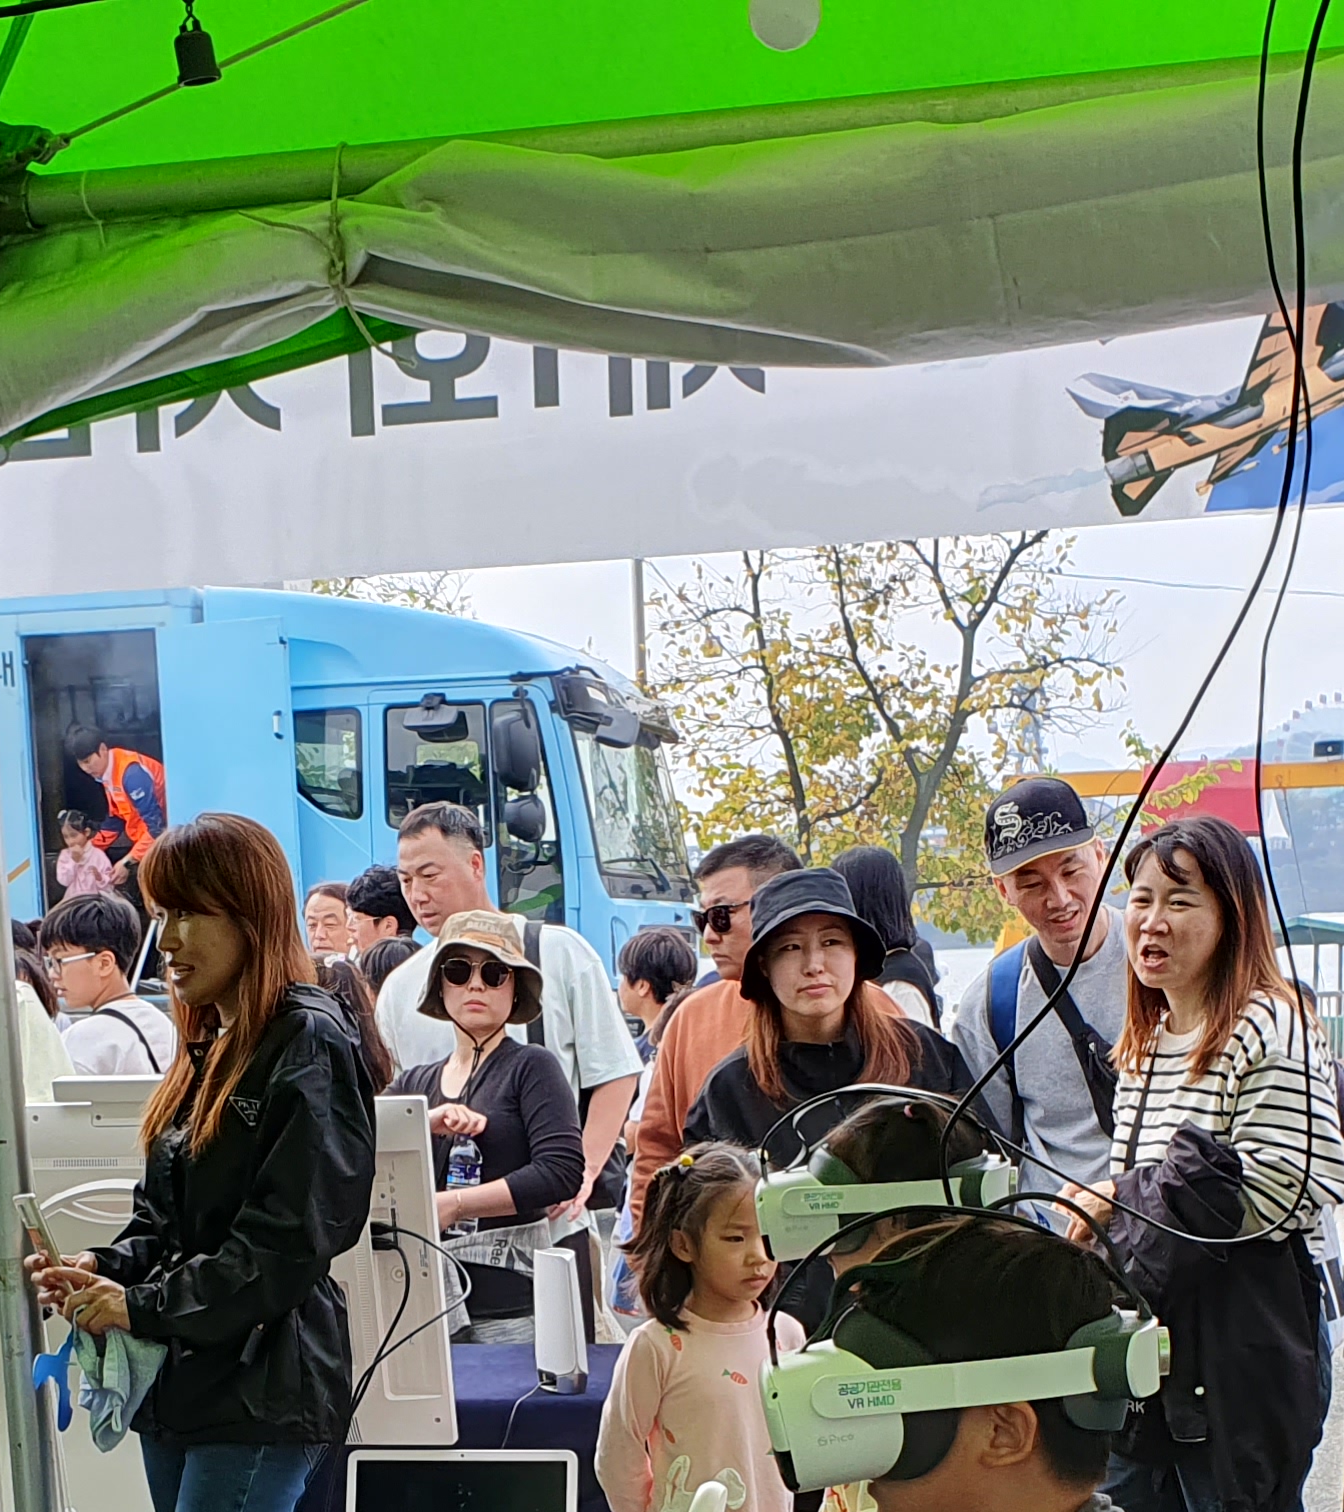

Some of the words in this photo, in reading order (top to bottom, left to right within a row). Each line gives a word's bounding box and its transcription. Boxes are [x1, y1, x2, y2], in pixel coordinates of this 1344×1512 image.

[838, 1378, 902, 1396] 공공기관전용
[848, 1398, 864, 1409] VR
[868, 1395, 895, 1407] HMD
